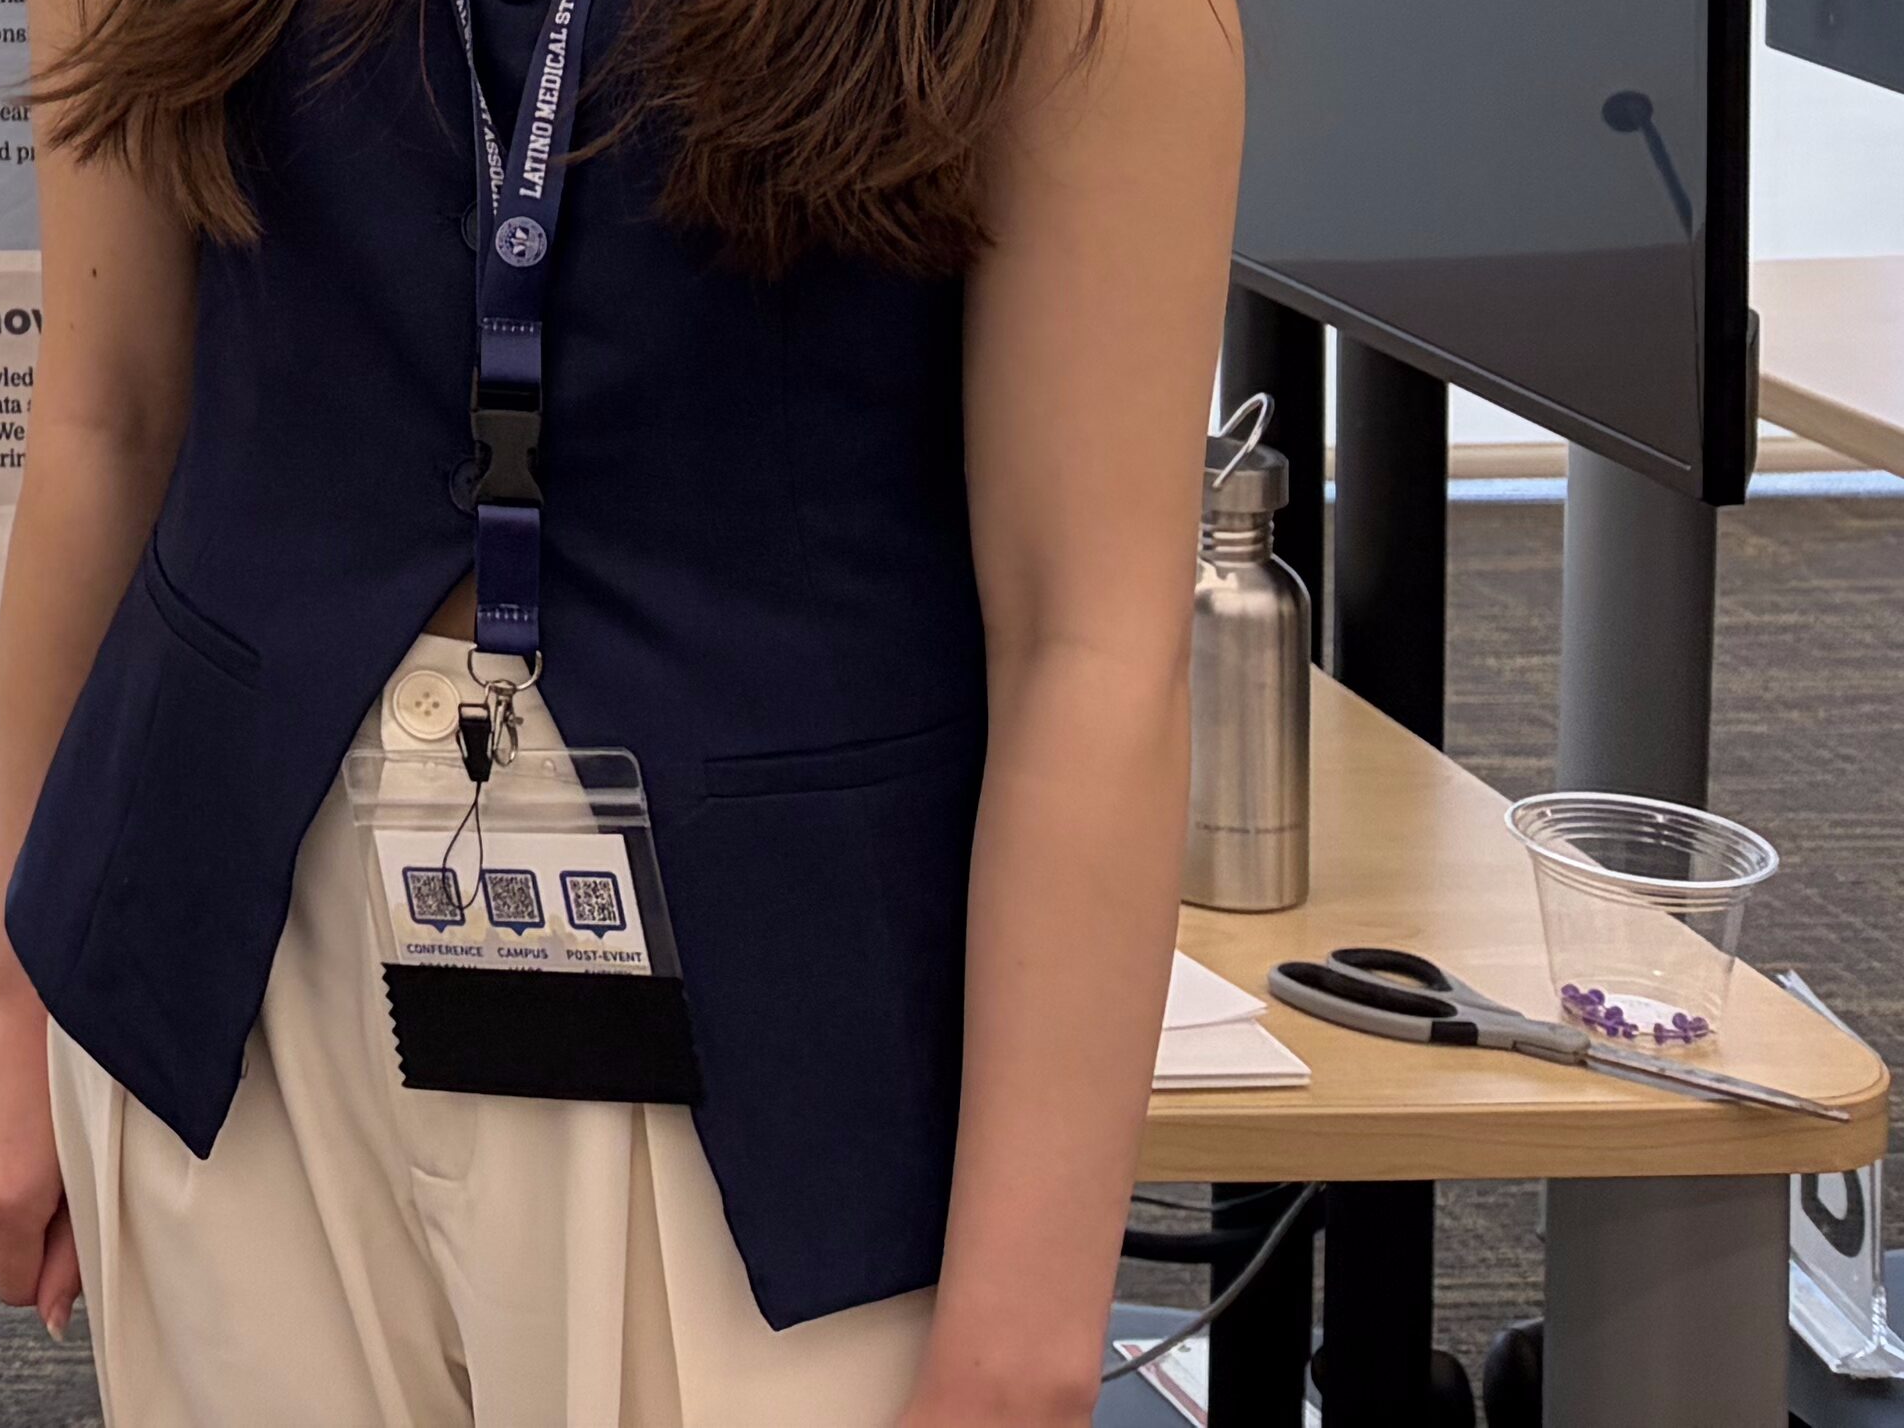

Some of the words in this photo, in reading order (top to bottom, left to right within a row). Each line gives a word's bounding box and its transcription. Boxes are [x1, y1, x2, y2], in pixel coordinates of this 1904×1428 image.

[533, 27, 569, 125] MEDICAL
[518, 120, 554, 201] LATINO
[405, 941, 484, 959] CONFERENCE
[496, 945, 549, 961] CAMPUS
[565, 948, 643, 964] POST-EVENT
